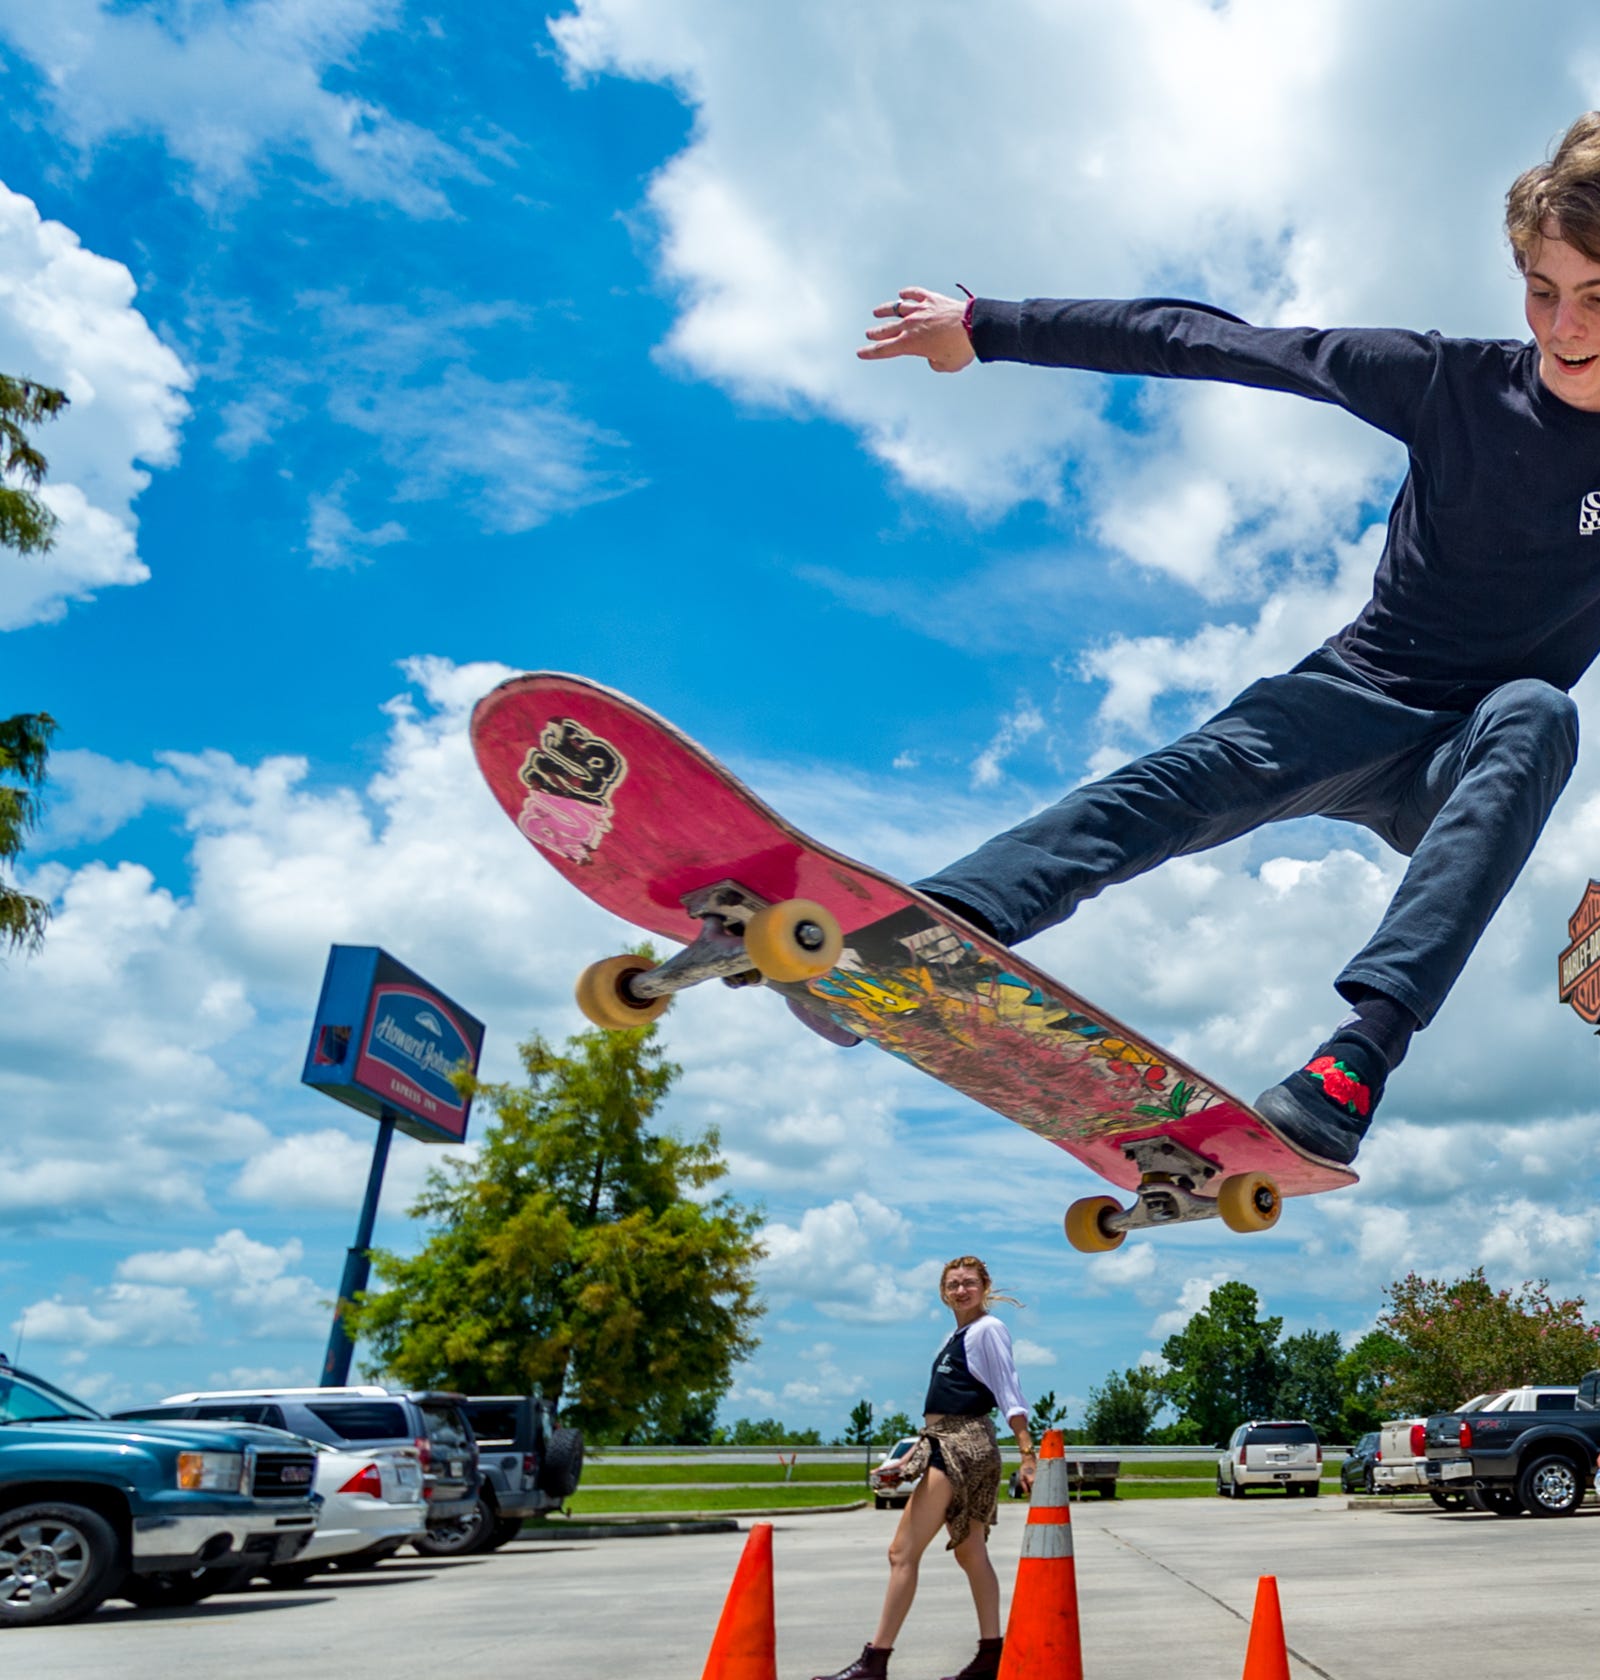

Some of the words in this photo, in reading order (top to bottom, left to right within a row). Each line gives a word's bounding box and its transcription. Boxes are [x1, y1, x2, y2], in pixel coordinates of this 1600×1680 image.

[375, 1014, 427, 1060] Howard
[391, 1078, 421, 1105] EXPRESS
[423, 1098, 437, 1112] INN
